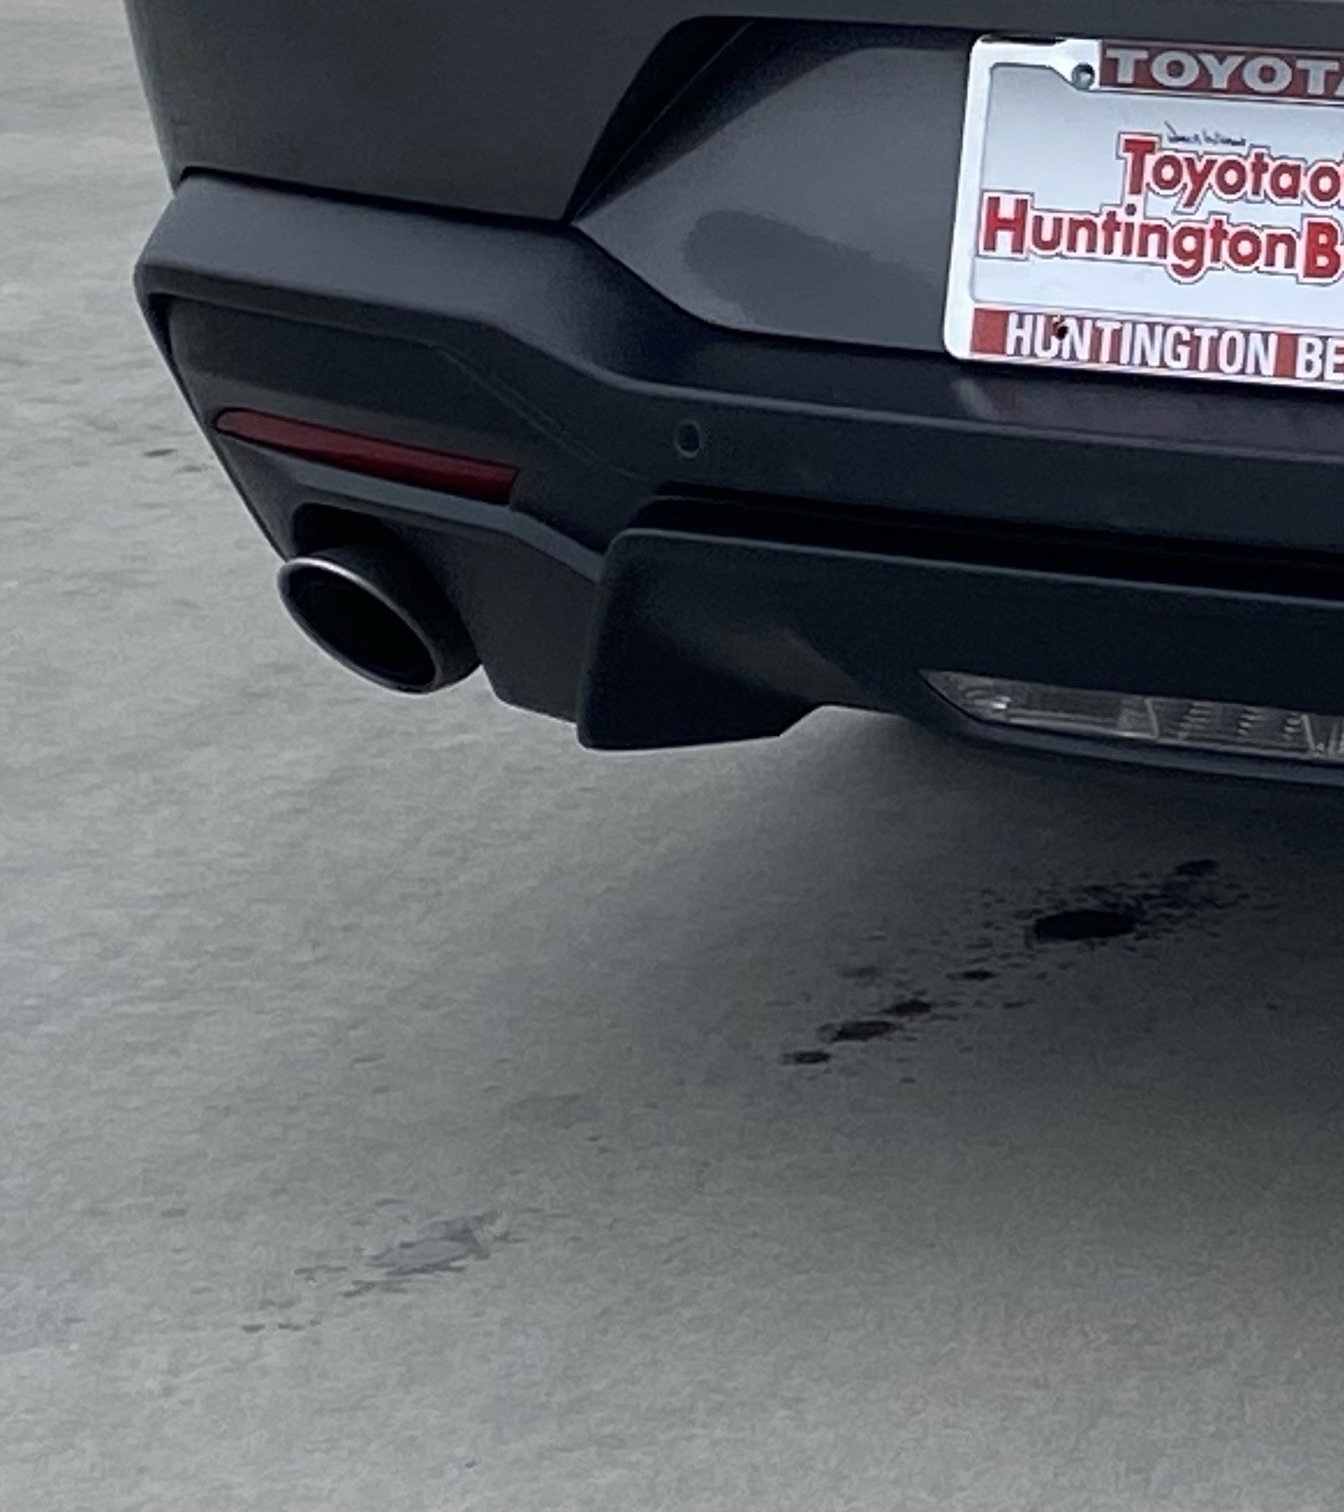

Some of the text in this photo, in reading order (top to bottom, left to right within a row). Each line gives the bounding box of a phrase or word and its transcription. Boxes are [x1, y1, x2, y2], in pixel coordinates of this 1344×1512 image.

[1123, 139, 1302, 208] Toyota
[983, 196, 1296, 277] Huntington
[1005, 312, 1278, 377] HUNTINGTON
